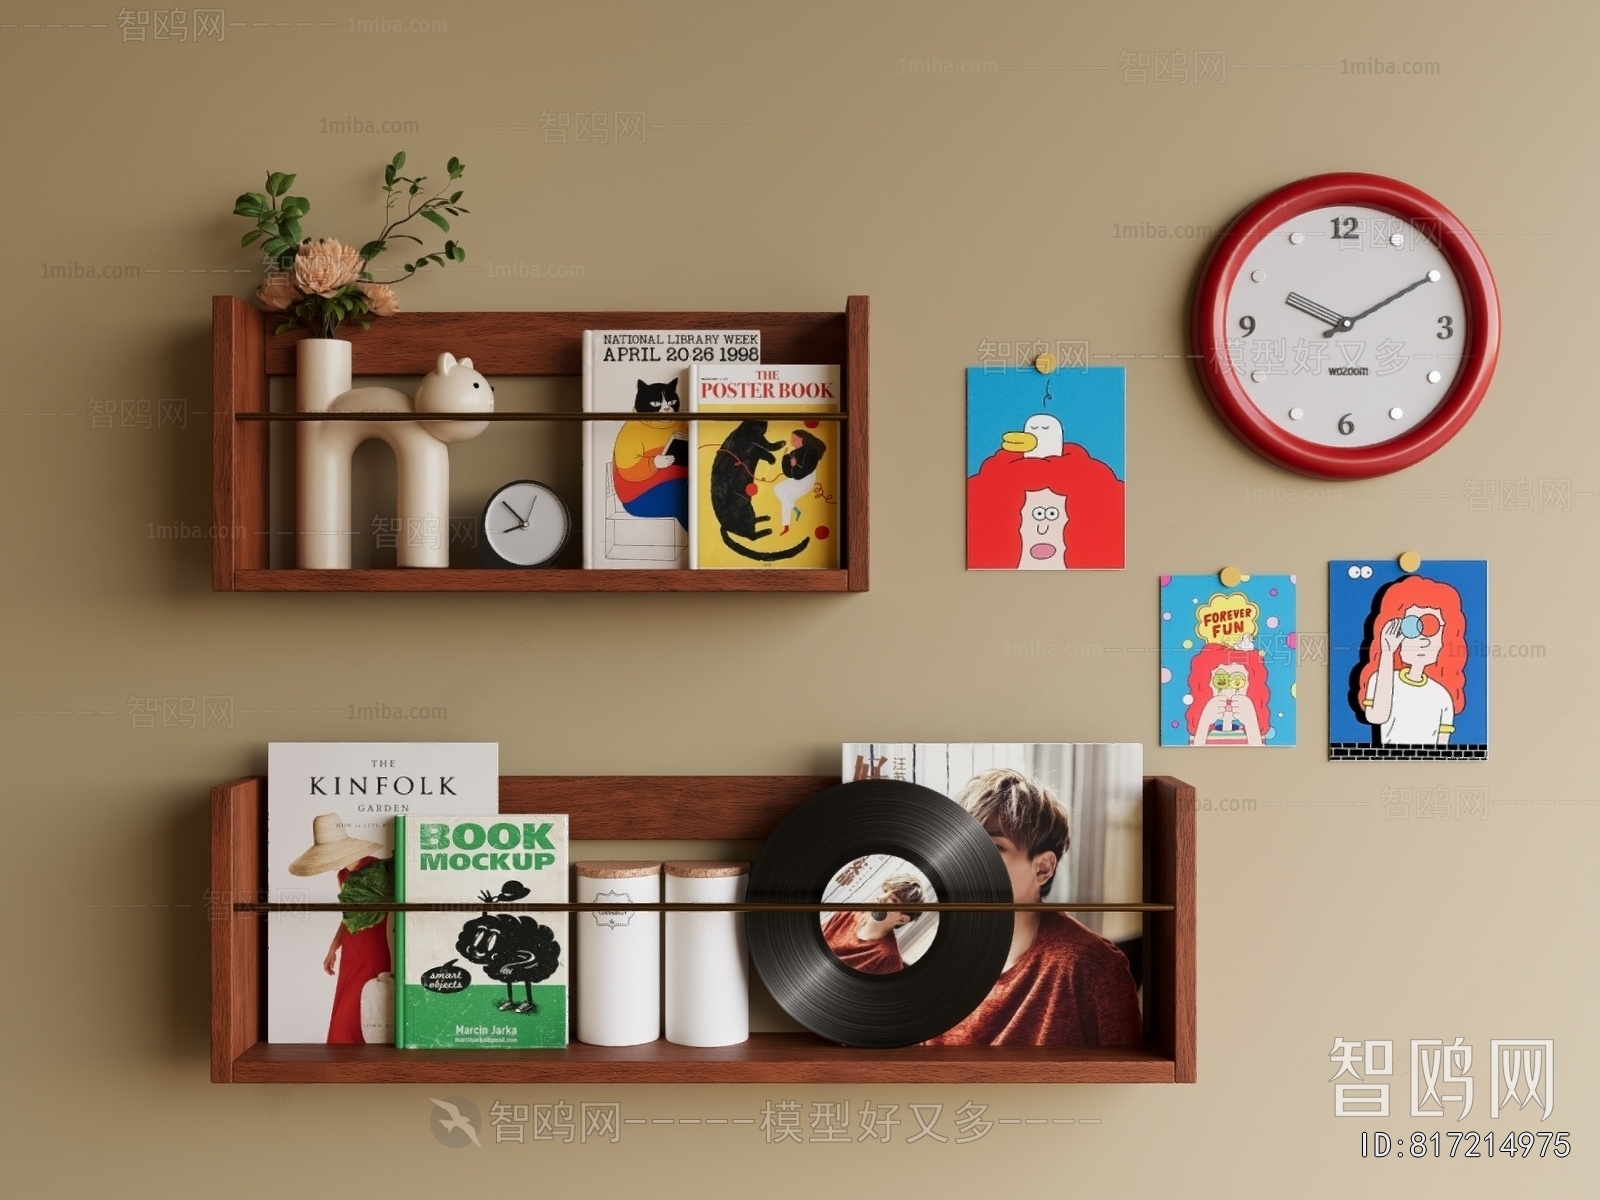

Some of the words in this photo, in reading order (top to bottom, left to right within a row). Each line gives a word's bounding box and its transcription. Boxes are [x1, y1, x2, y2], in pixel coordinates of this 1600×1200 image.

[1330, 217, 1360, 239] 12
[1239, 315, 1256, 338] 9
[1436, 315, 1454, 339] 3
[603, 334, 664, 345] NATIONAL
[667, 334, 719, 345] LIBRARY
[723, 334, 758, 345] WEEK
[602, 347, 661, 362] APRIL
[719, 347, 759, 362] 1998
[755, 370, 780, 381] THE
[701, 382, 776, 399] POSTER
[779, 382, 834, 399] BOOK
[1338, 413, 1355, 435] 6
[1203, 608, 1252, 627] FOREVER
[1212, 621, 1244, 639] FUN
[371, 759, 396, 768] THE
[309, 775, 458, 796] KINFOLK
[357, 804, 410, 812] GARDEN
[420, 822, 556, 850] BOOK
[420, 853, 555, 871] MOCKUP
[429, 970, 462, 979] smart
[429, 979, 463, 991] objects
[455, 1024, 488, 1035] Marcin
[490, 1024, 517, 1035] Jarka
